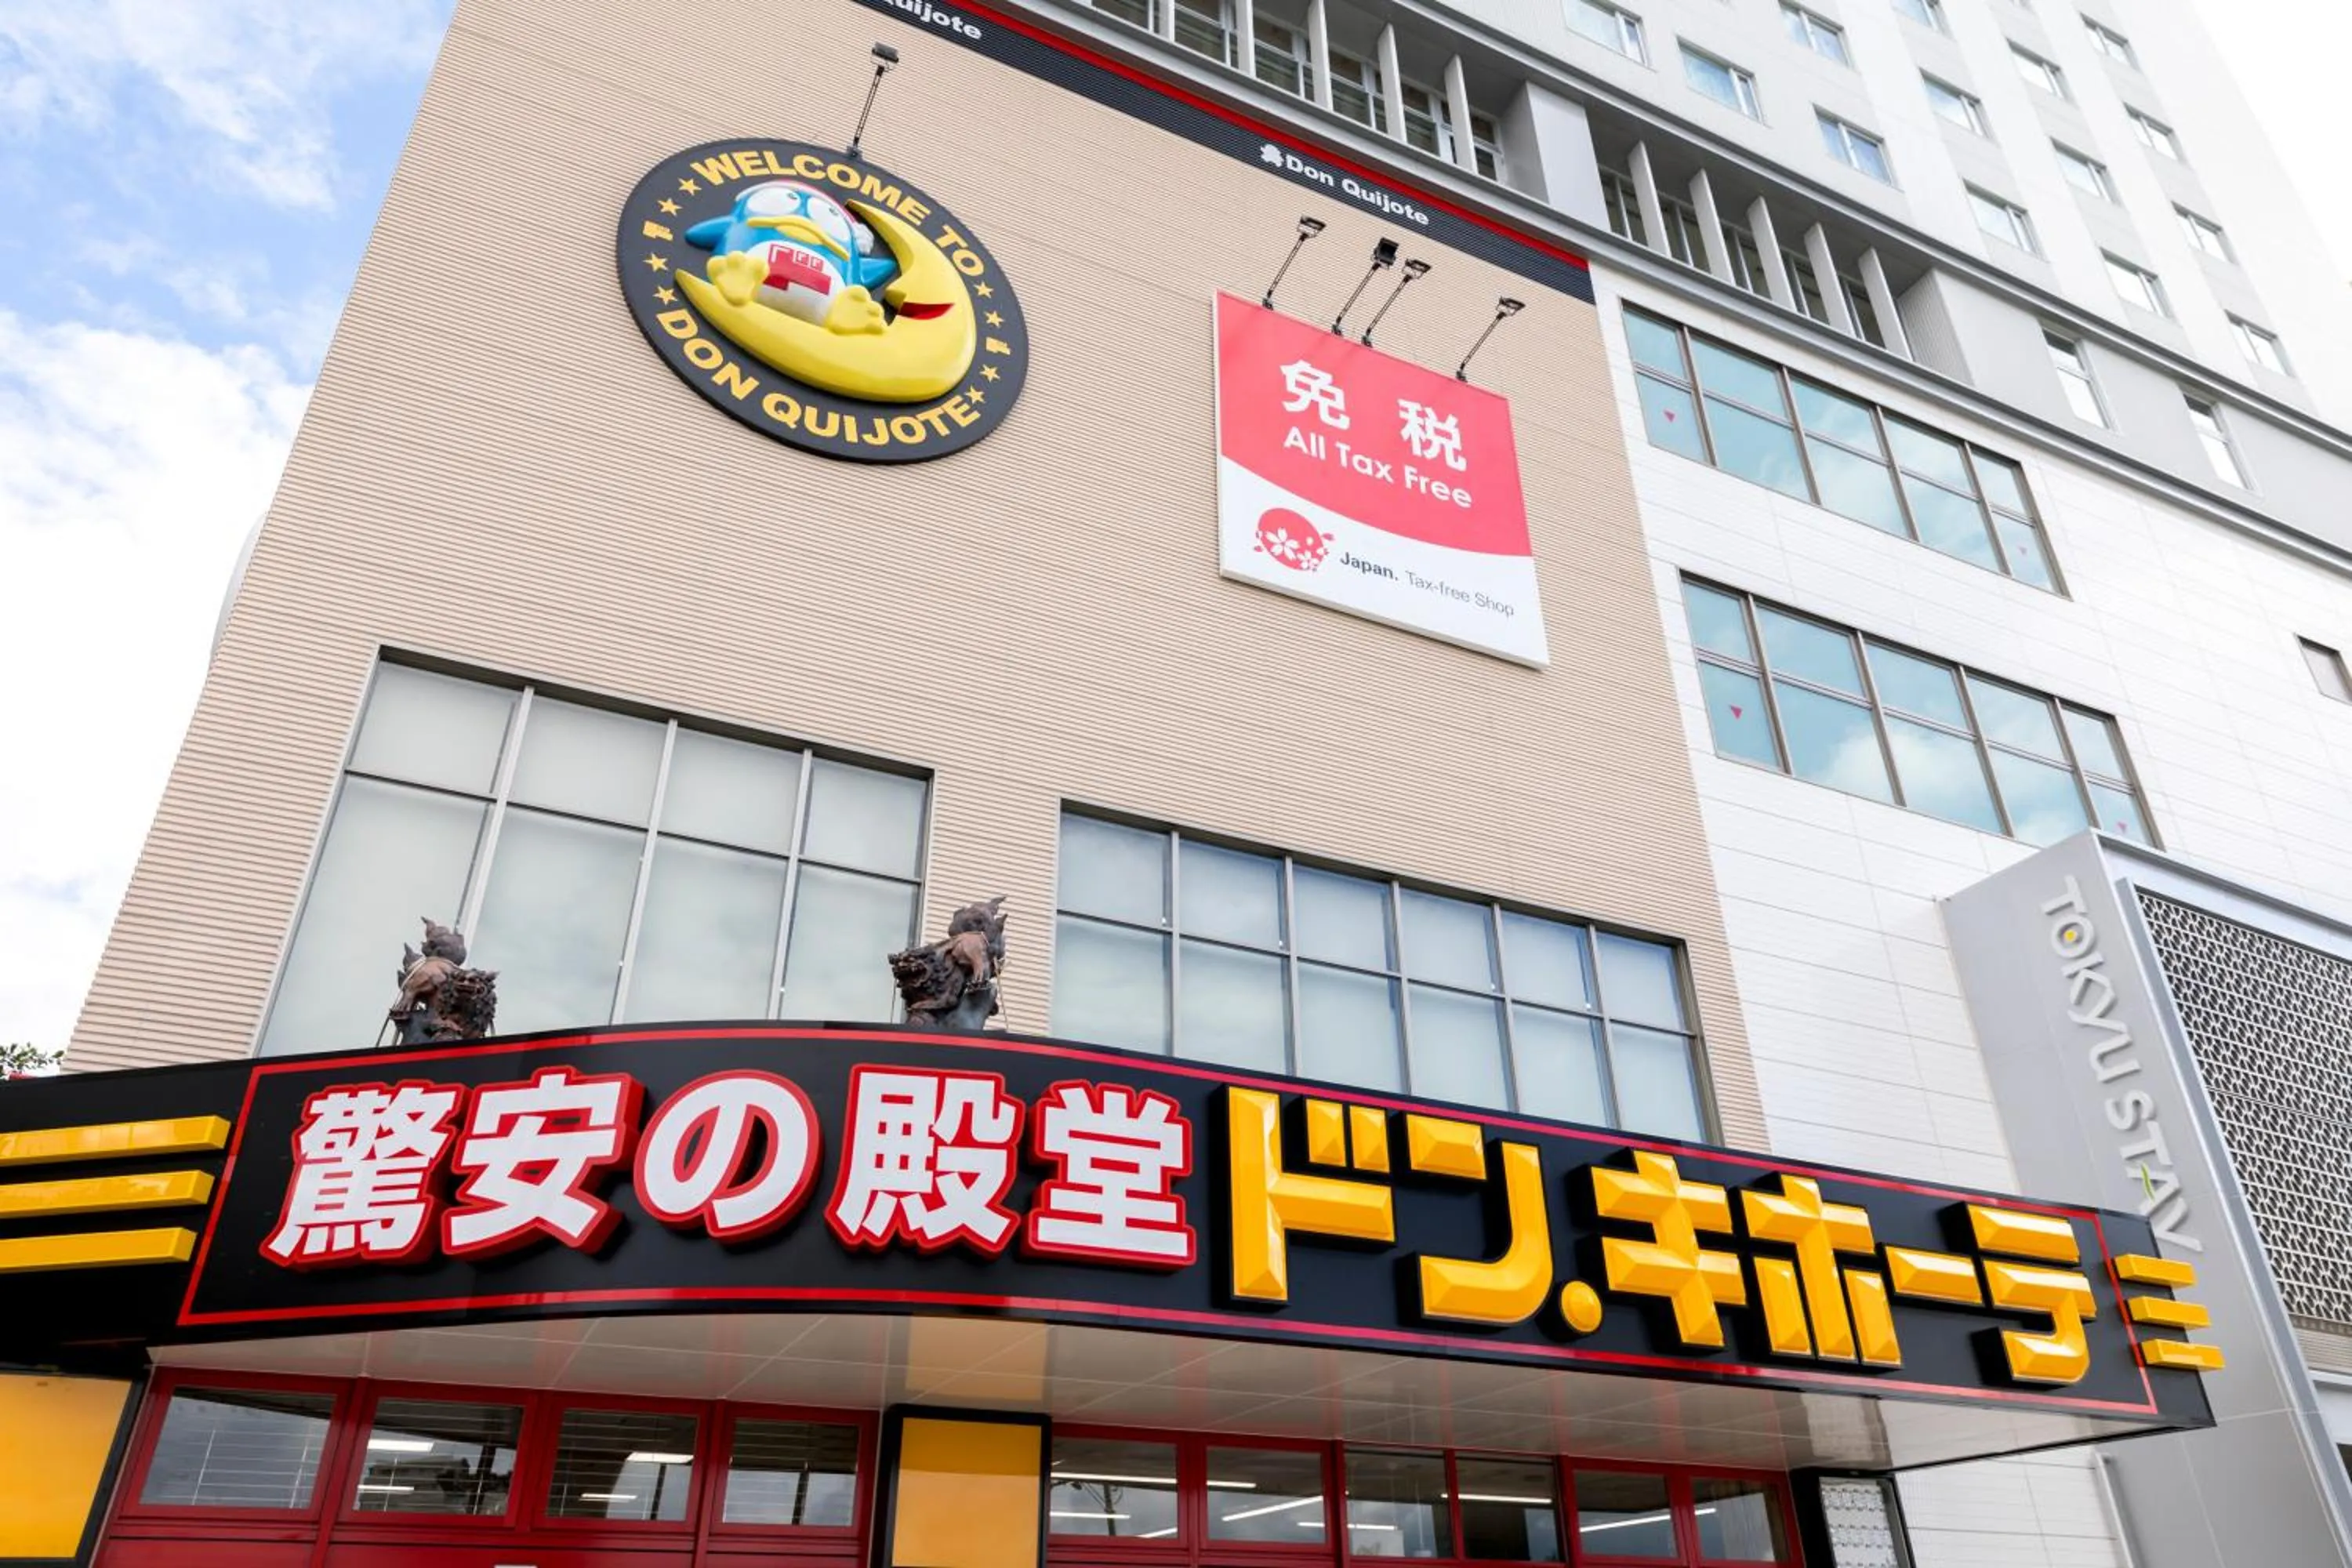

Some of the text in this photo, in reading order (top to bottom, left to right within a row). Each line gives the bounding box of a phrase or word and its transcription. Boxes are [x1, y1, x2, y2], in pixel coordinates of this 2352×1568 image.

[883, 0, 982, 39] uijote
[691, 151, 985, 278] WELCOME TO
[1285, 154, 1429, 226] Don Quijote
[656, 307, 982, 446] DON QUIJOTE
[1283, 426, 1473, 510] All Tax Free
[1339, 551, 1515, 618] Japan. Tax-free Shop
[2039, 874, 2204, 1254] TOKYU STAY
[264, 1066, 1194, 1262] 驚安の殿堂
